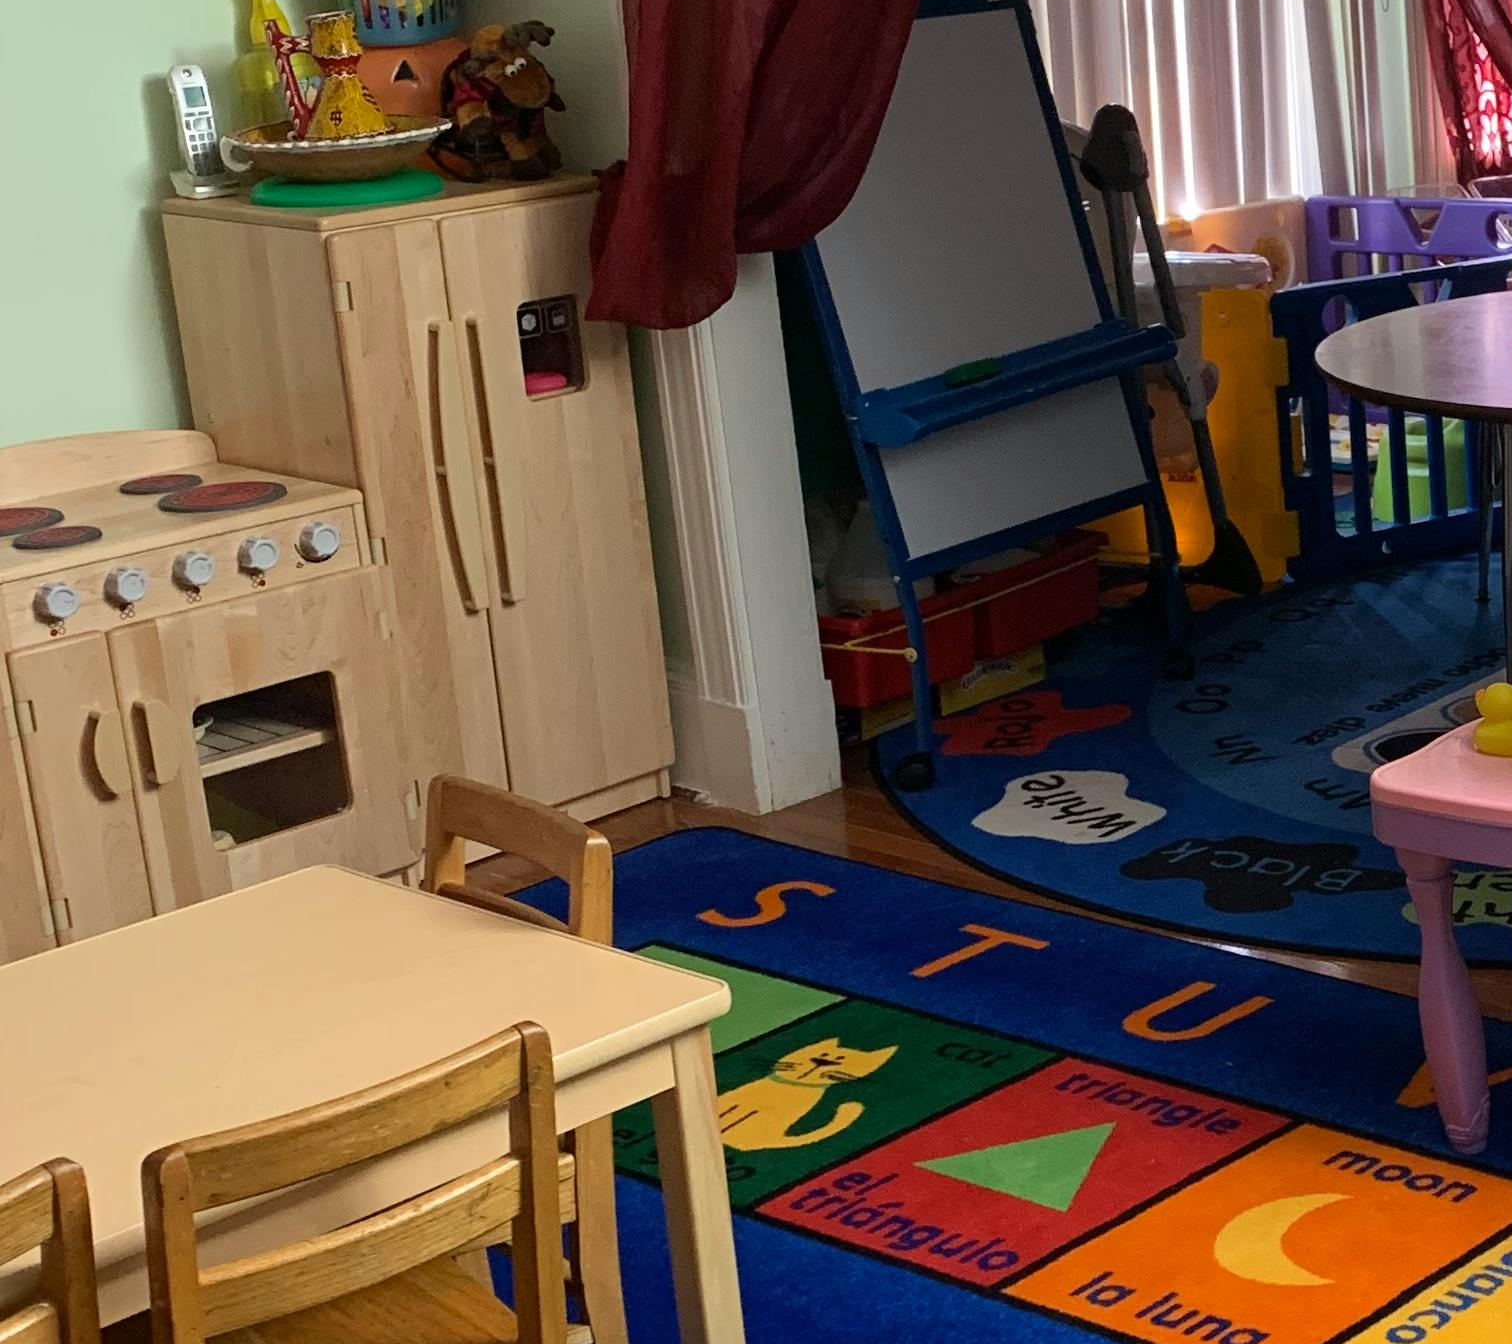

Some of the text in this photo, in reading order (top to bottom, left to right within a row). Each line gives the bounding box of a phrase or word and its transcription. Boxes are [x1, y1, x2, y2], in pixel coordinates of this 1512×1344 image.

[1021, 775, 1137, 838] White
[1160, 841, 1362, 892] Black
[696, 880, 838, 928] S
[909, 923, 1050, 978] T
[1121, 981, 1274, 1041] U
[935, 1042, 1010, 1070] cat
[1054, 1069, 1242, 1136] triangle
[831, 1167, 899, 1198] el
[1322, 1148, 1480, 1204] moon
[791, 1183, 1021, 1271] triángulo
[1069, 1270, 1128, 1308] la
